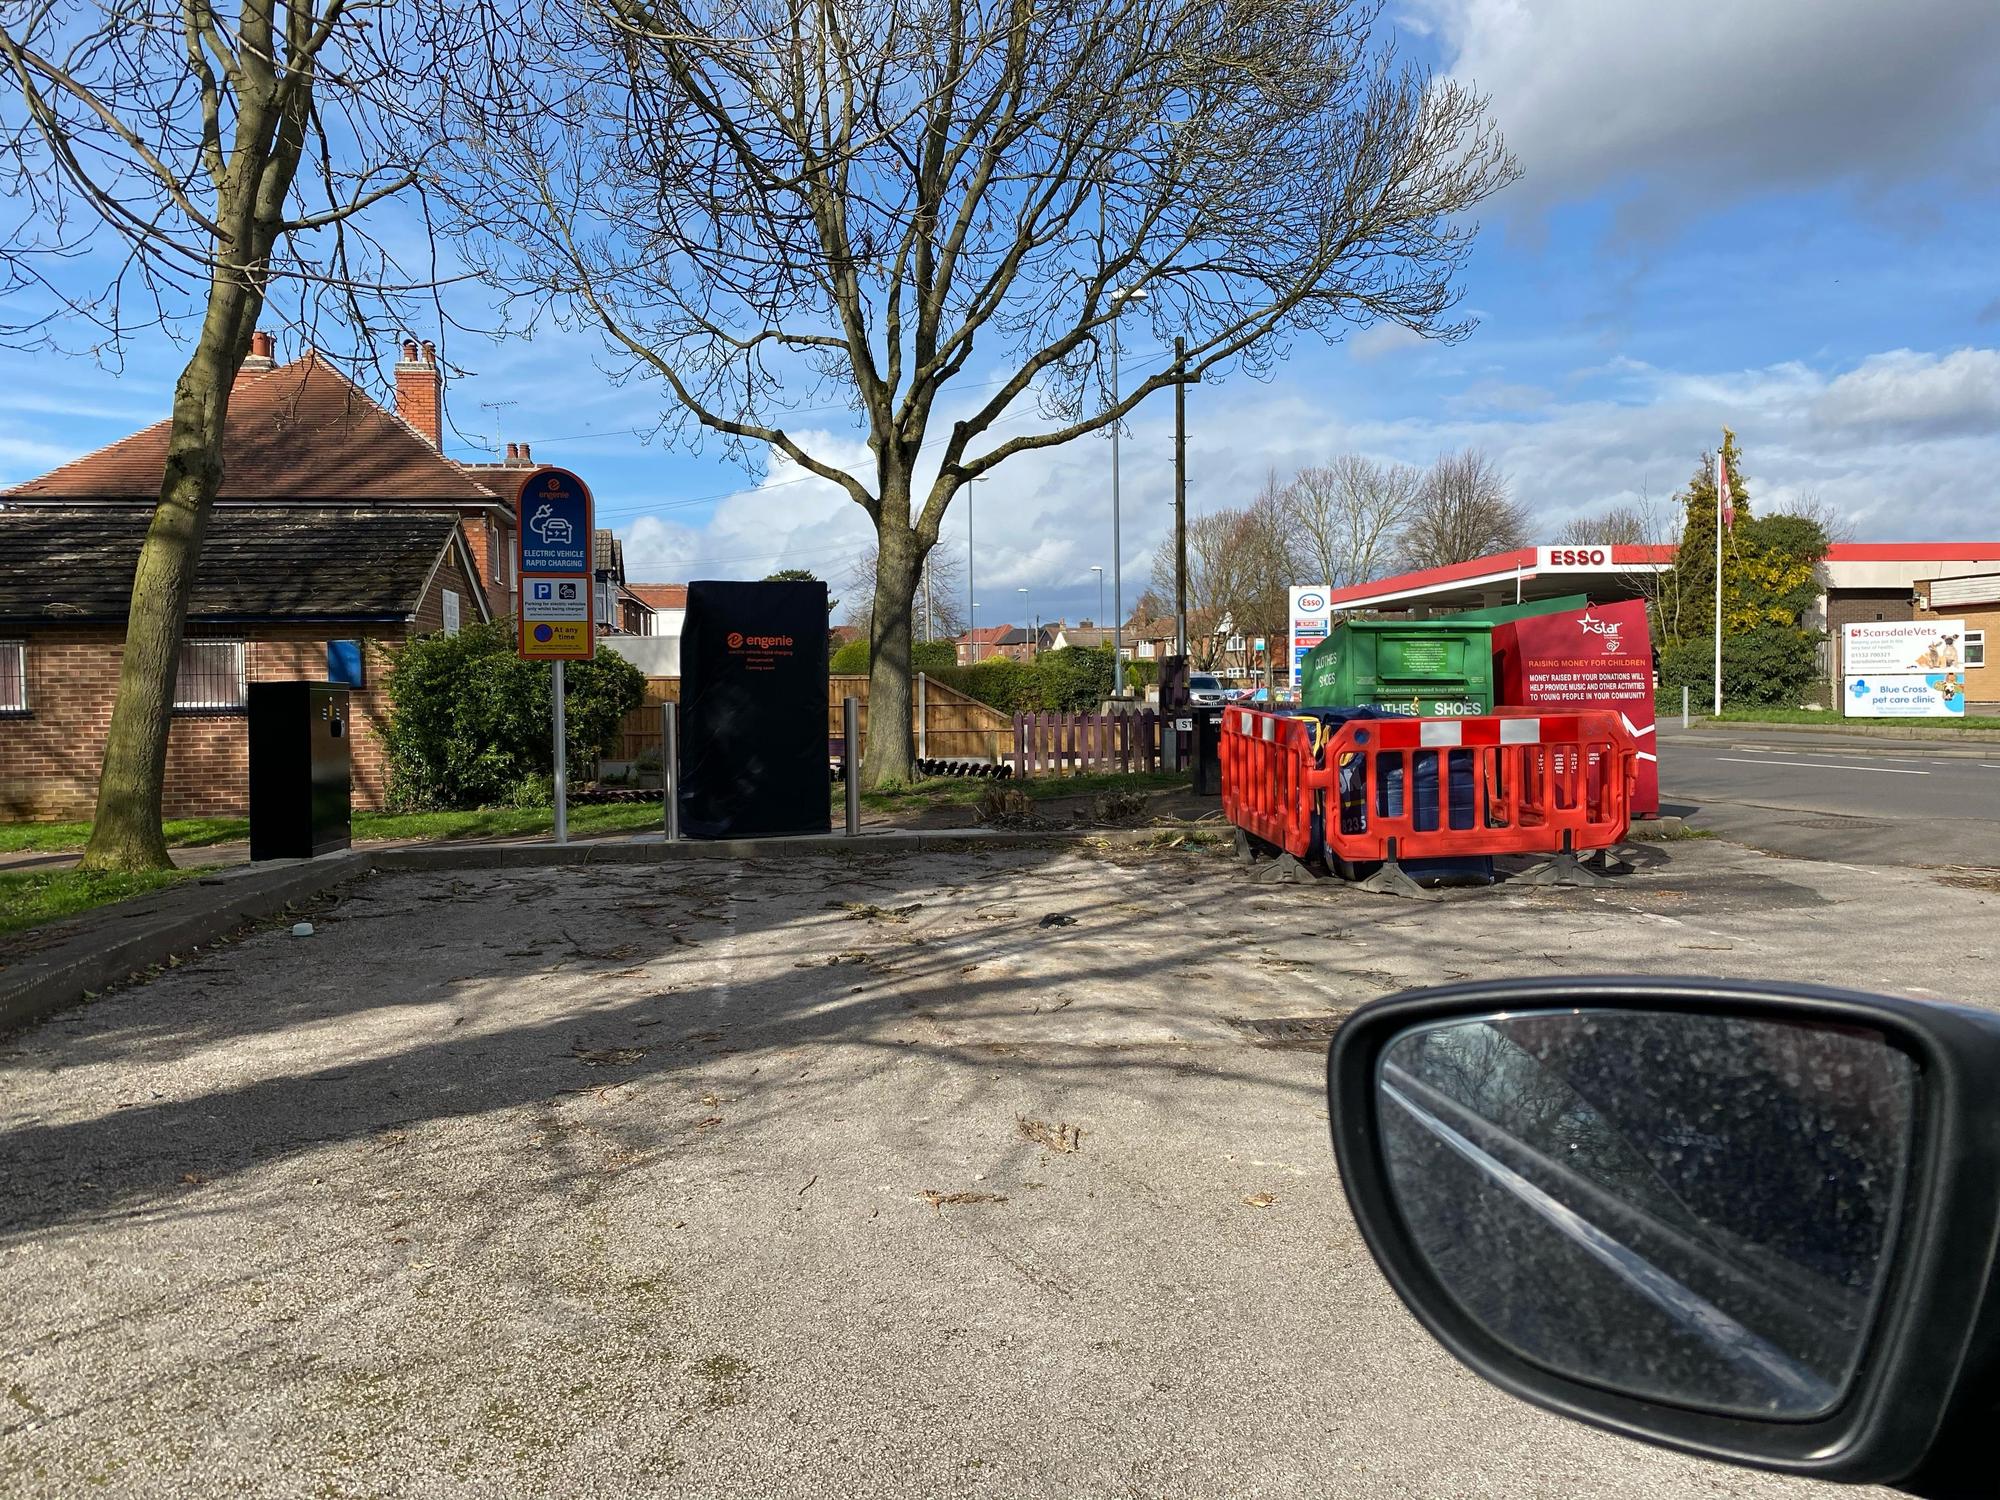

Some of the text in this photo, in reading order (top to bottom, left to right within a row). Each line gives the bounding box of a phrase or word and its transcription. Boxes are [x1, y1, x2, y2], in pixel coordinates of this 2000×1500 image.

[557, 550, 584, 558] VEHICLE
[1551, 550, 1604, 566] ESSO
[538, 585, 549, 598] P
[1302, 598, 1320, 606] Esso
[1594, 622, 1620, 634] star
[746, 634, 793, 649] engenie
[1315, 652, 1337, 670] CLOTHES
[1319, 672, 1335, 687] SHOES
[1872, 696, 1887, 705] pet
[1434, 702, 1481, 716] SHOES
